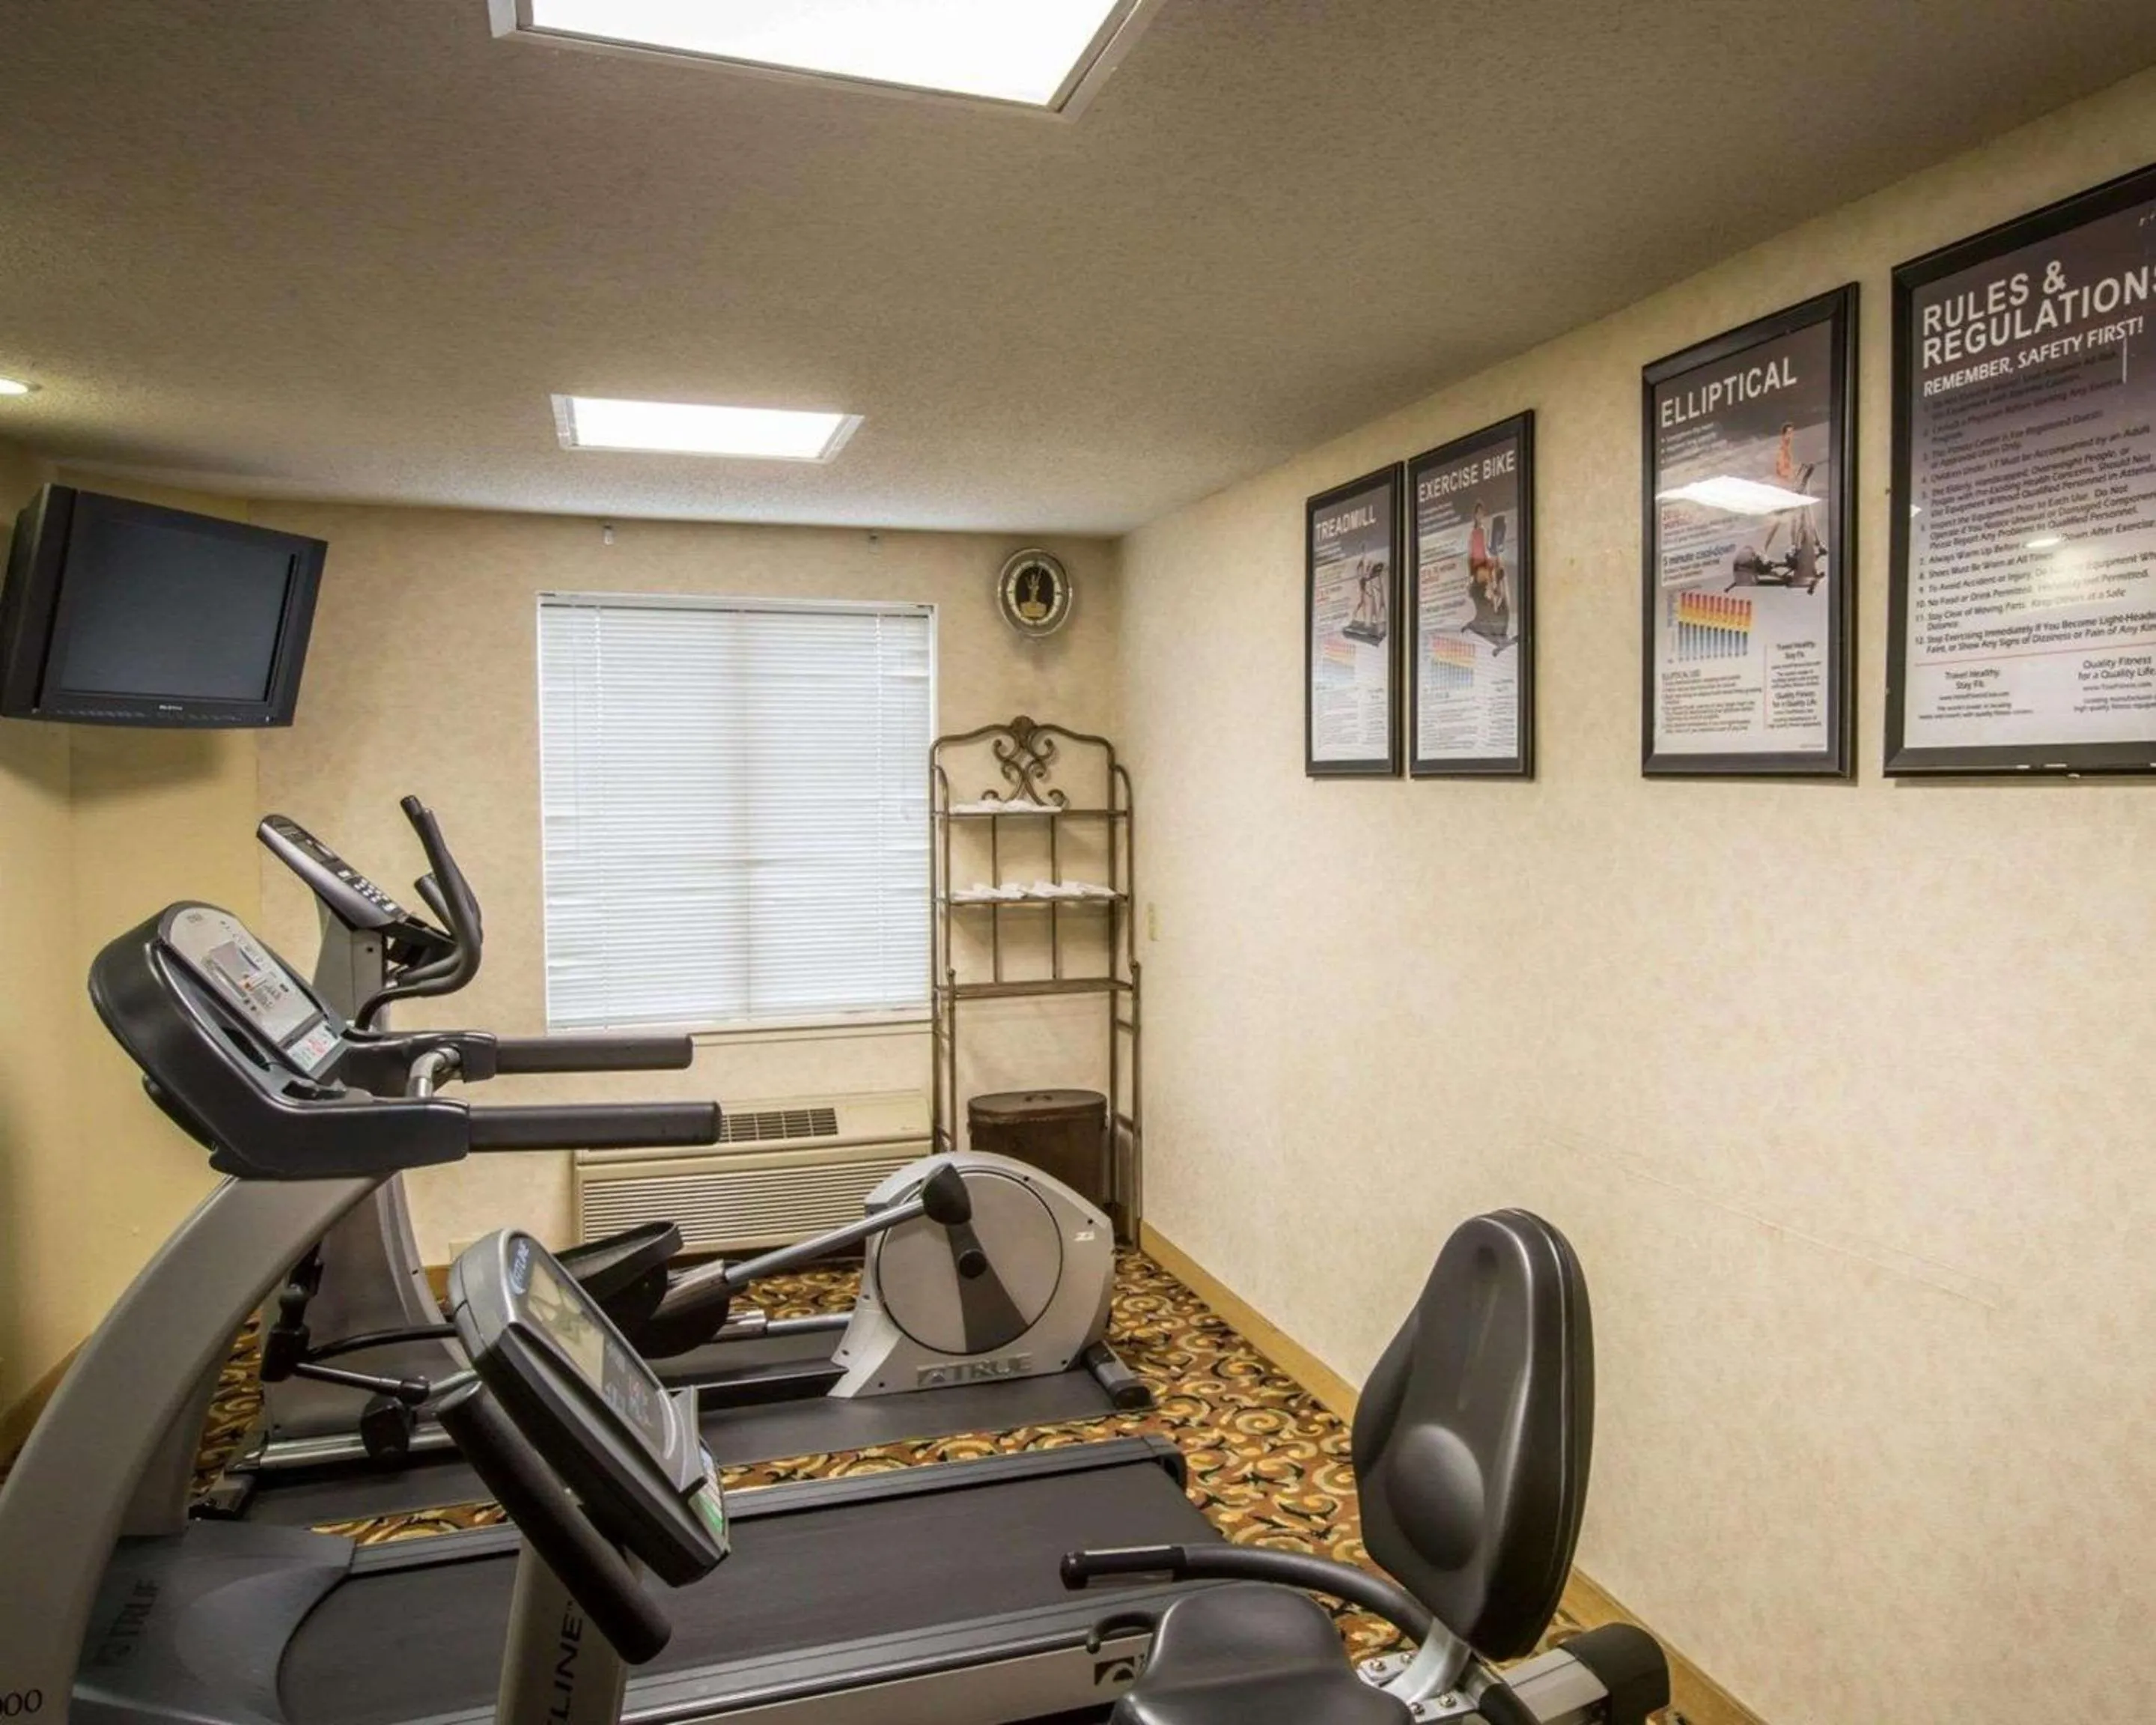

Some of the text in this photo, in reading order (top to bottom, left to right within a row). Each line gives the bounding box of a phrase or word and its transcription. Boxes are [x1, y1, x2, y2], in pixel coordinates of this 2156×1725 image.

[1923, 261, 2066, 336] RULES &
[1923, 266, 2156, 368] REGULATION
[1924, 357, 2014, 398] REMEMBER,
[2018, 334, 2083, 368] SAFETY
[2087, 316, 2144, 348] FIRST!
[1661, 356, 1797, 428] ELLIPTICAL
[1419, 450, 1515, 503] EXERCISE BIKE
[1316, 505, 1377, 542] TREADMILL
[2083, 655, 2152, 671] Quality Fitness
[2101, 668, 2136, 681] Quality
[0, 1689, 43, 1718] 00
